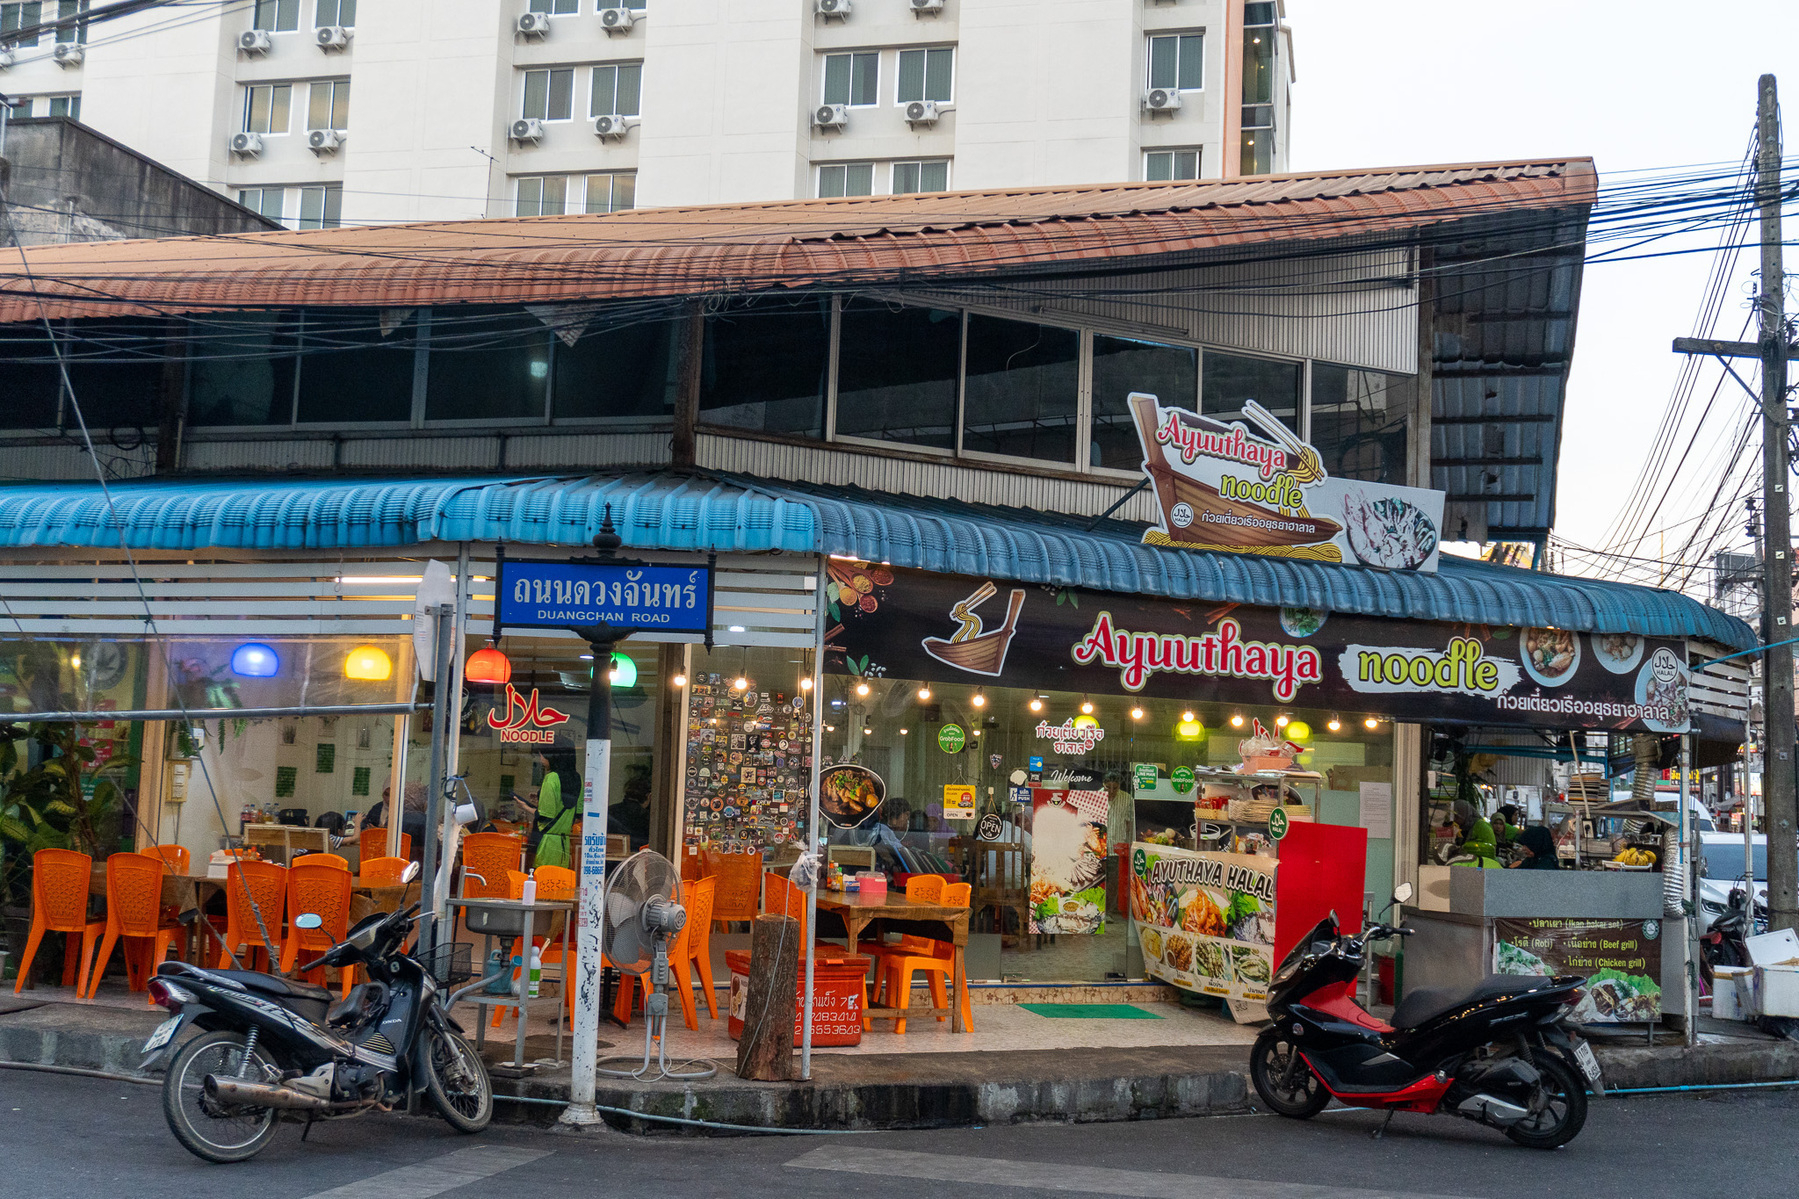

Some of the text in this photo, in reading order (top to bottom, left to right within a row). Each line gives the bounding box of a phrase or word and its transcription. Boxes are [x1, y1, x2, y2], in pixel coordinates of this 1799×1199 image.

[1156, 411, 1287, 478] Ayuuthaya
[1220, 473, 1303, 507] noodle
[514, 570, 698, 608] ถนนดวงจันทร์
[537, 610, 670, 624] DUANGCHAN ROAD
[1073, 614, 1499, 699] Ayuuthaya noodle
[488, 683, 570, 730] حلال
[500, 729, 555, 744] NOODLE
[1050, 768, 1093, 785] Welcome
[980, 820, 1001, 834] OPEN
[1151, 858, 1273, 900] AYUTHAYA HALAL
[1599, 939, 1620, 951] (Beef
[1621, 940, 1638, 951] grill)
[1595, 957, 1627, 969] (Chicken
[1628, 957, 1646, 969] grill)
